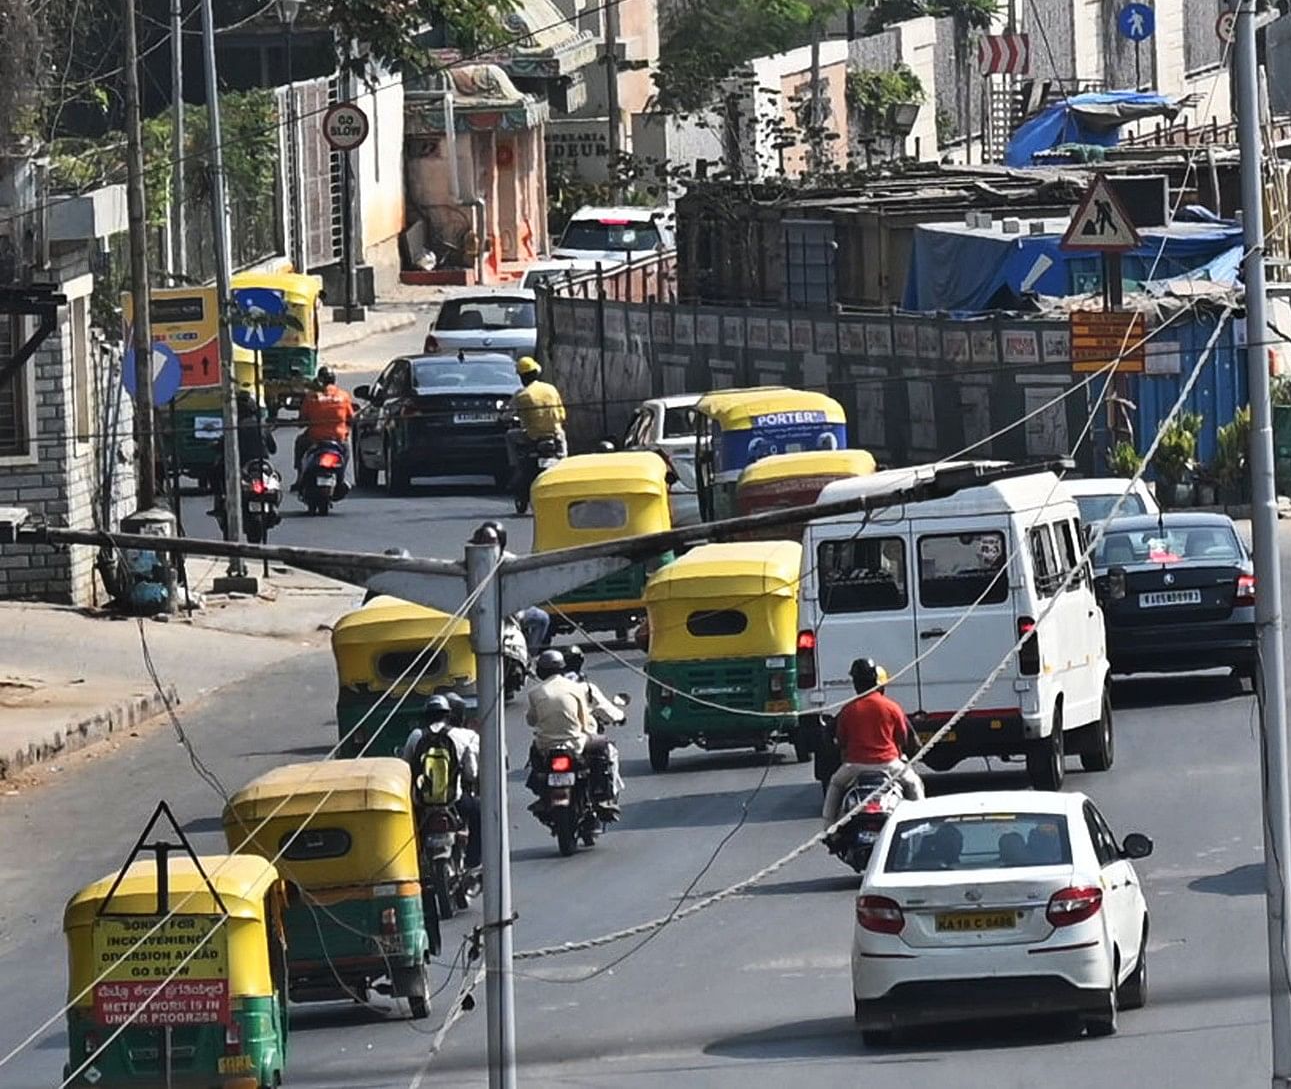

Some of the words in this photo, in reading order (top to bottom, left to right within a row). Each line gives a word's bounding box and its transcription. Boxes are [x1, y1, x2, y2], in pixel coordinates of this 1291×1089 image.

[757, 412, 813, 426] PORTER
[170, 918, 196, 928] FOR
[131, 966, 150, 976] GO
[154, 965, 190, 976] SLOW
[150, 1000, 186, 1011] WORK
[190, 1000, 202, 1010] IS
[206, 999, 220, 1009] IN
[151, 1012, 218, 1023] PROGRESS
